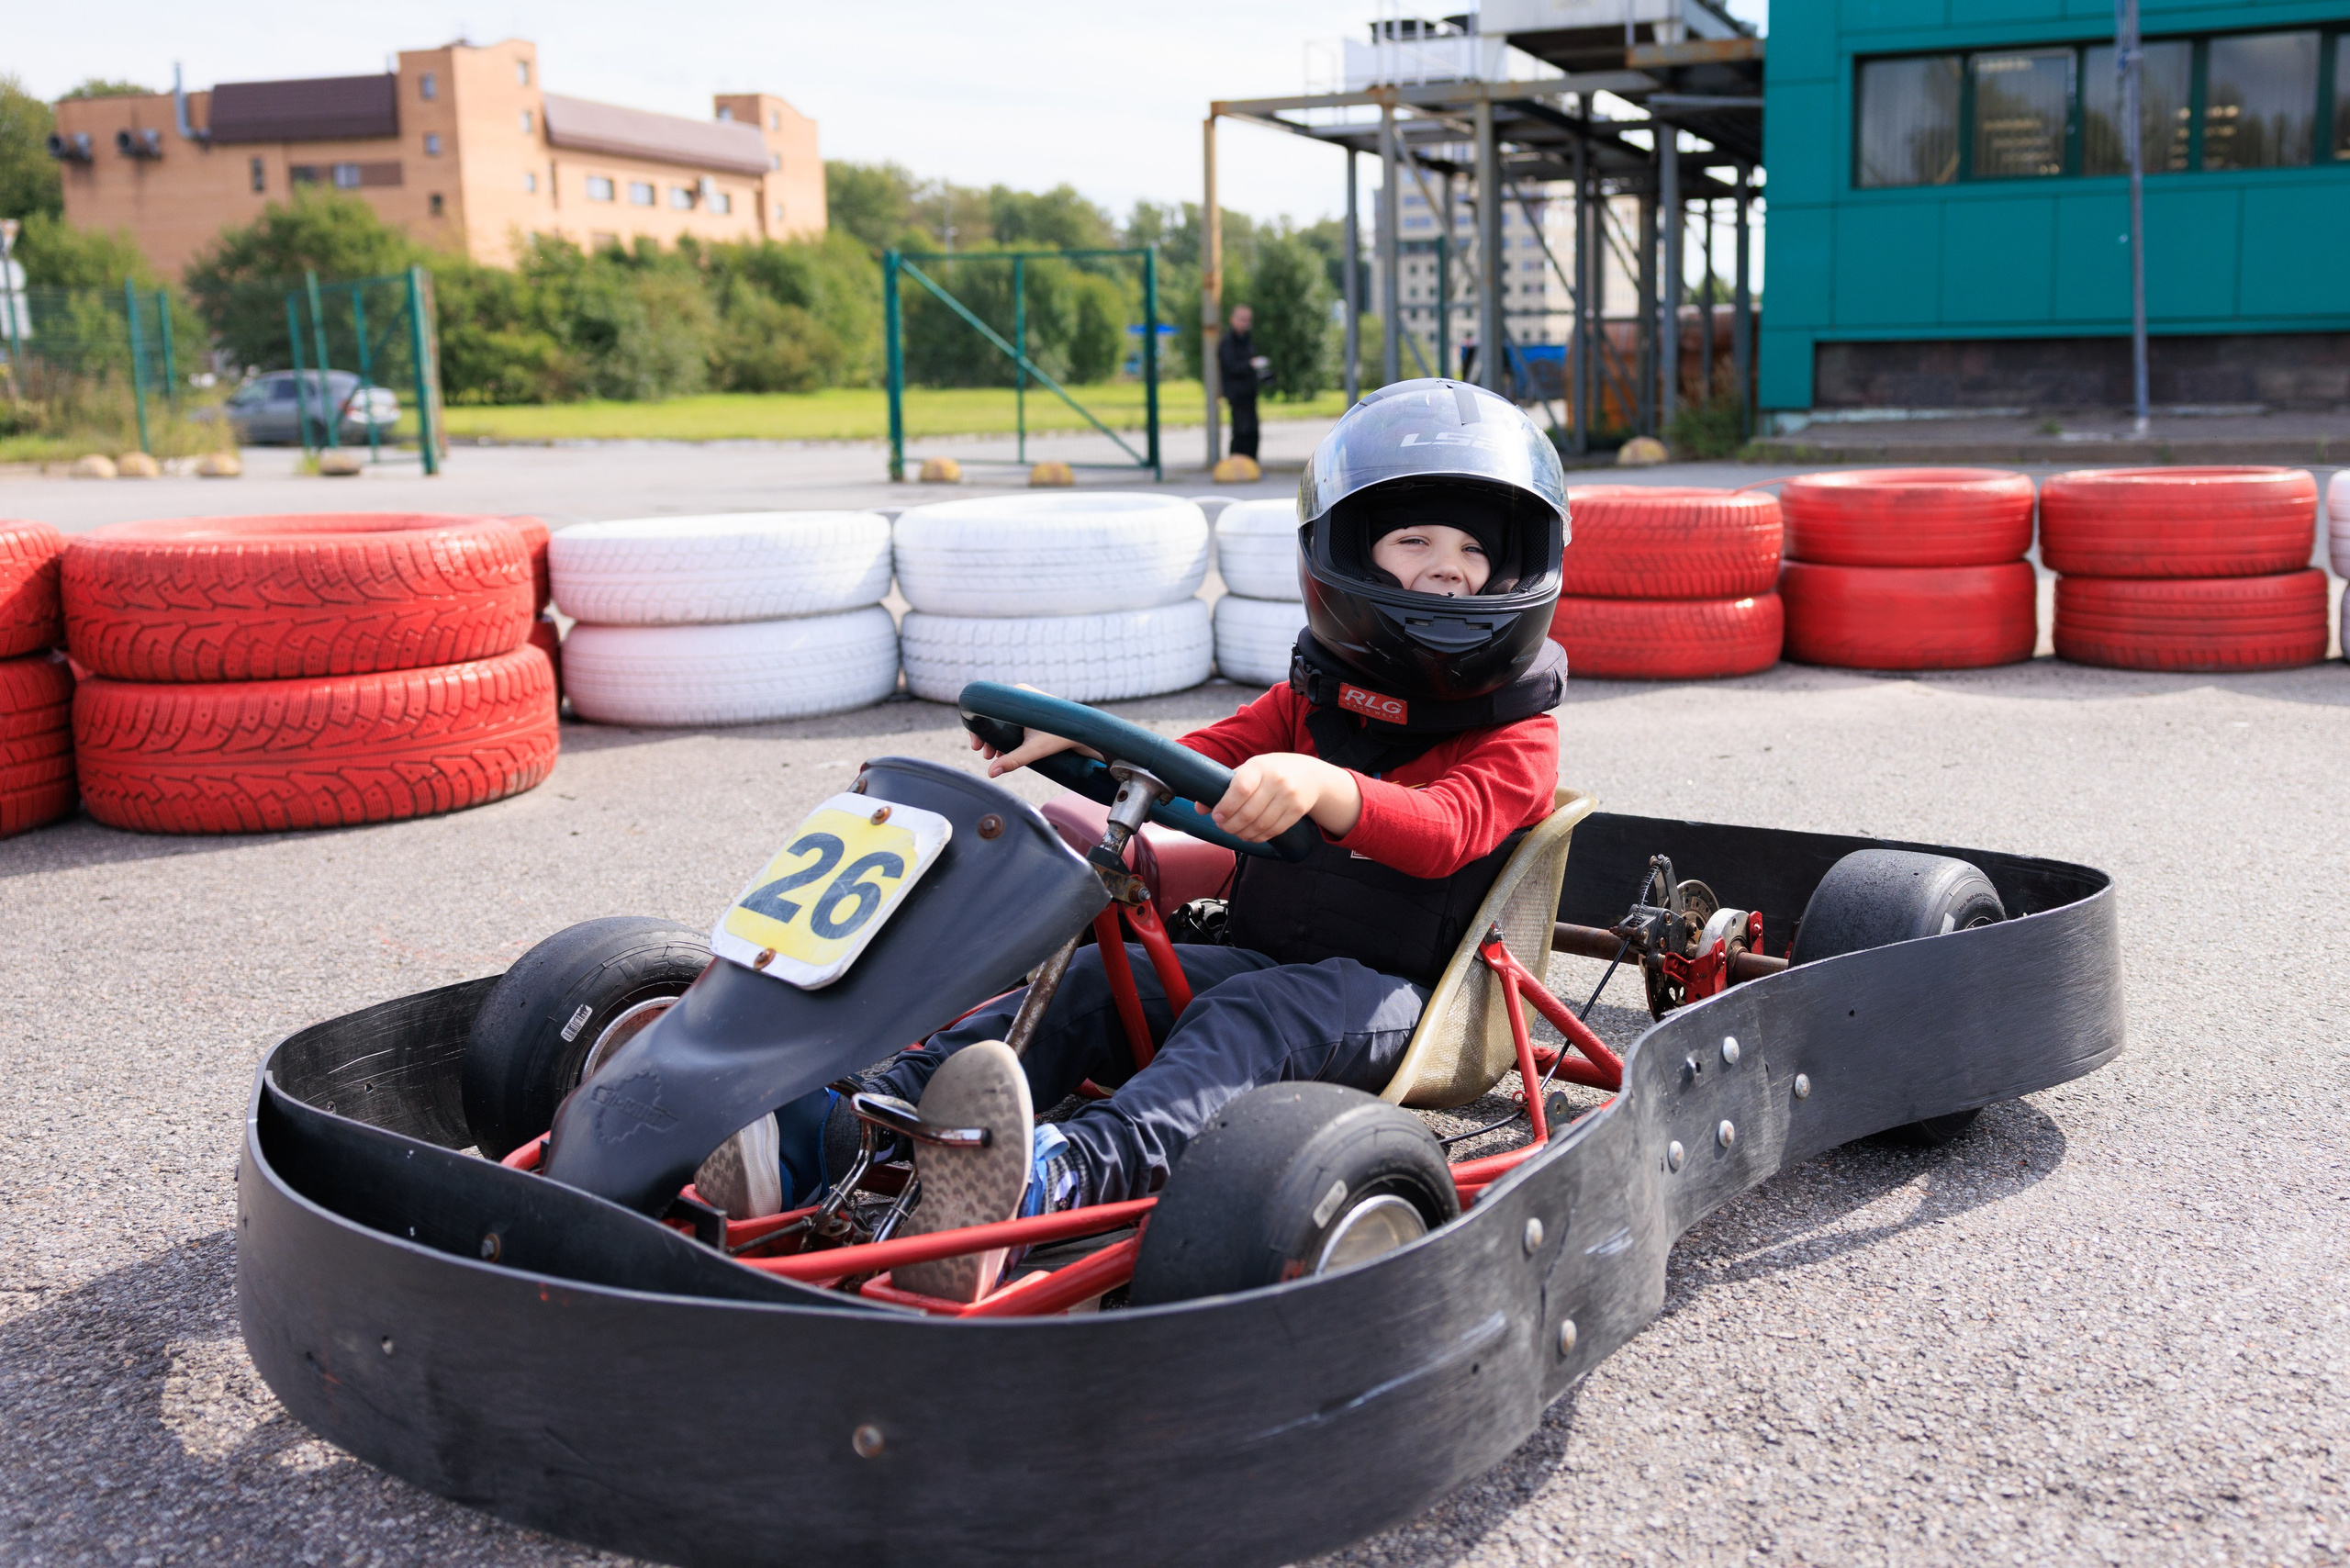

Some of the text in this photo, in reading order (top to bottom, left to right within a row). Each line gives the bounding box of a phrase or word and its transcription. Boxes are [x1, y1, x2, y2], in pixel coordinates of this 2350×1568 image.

[1400, 431, 1504, 454] LS2
[1345, 689, 1403, 714] RLG
[1374, 711, 1401, 721] WEAR
[738, 832, 905, 940] 26
